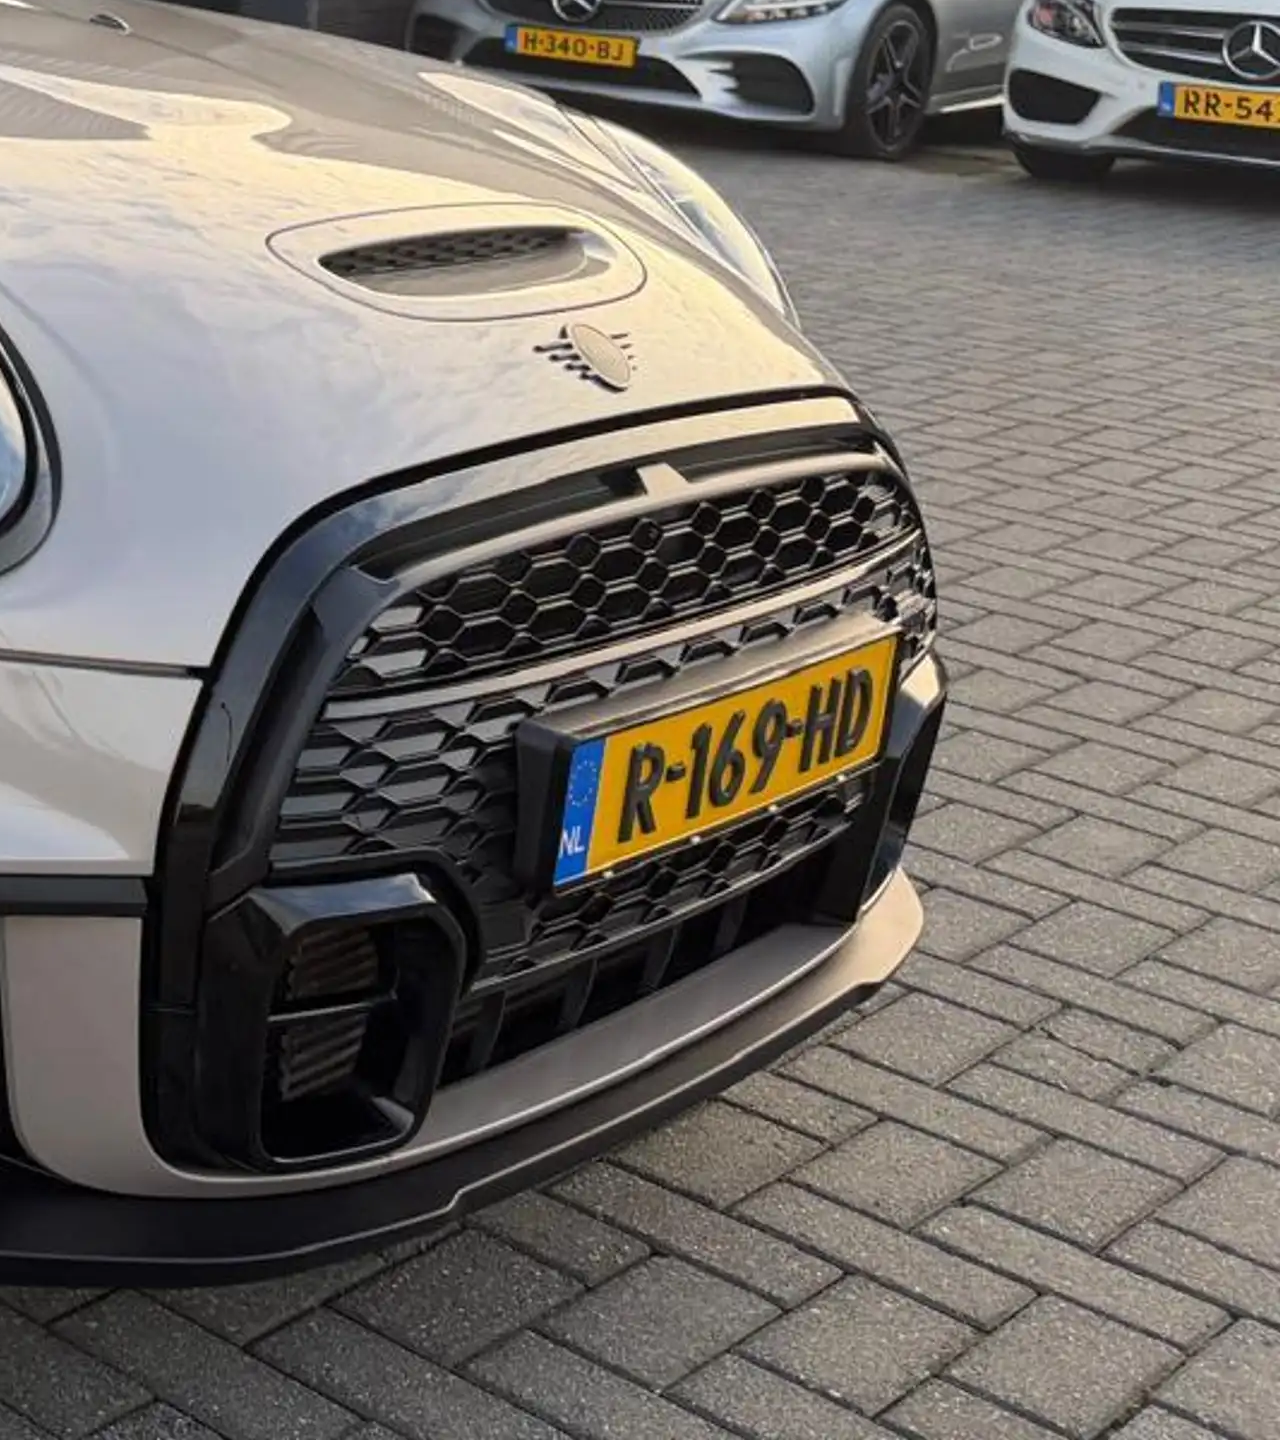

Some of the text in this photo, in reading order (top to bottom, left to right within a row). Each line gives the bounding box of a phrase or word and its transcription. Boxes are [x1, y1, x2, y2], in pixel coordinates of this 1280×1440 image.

[1183, 89, 1280, 122] RR-54
[617, 667, 874, 843] R-169-HD
[558, 825, 585, 859] NL
